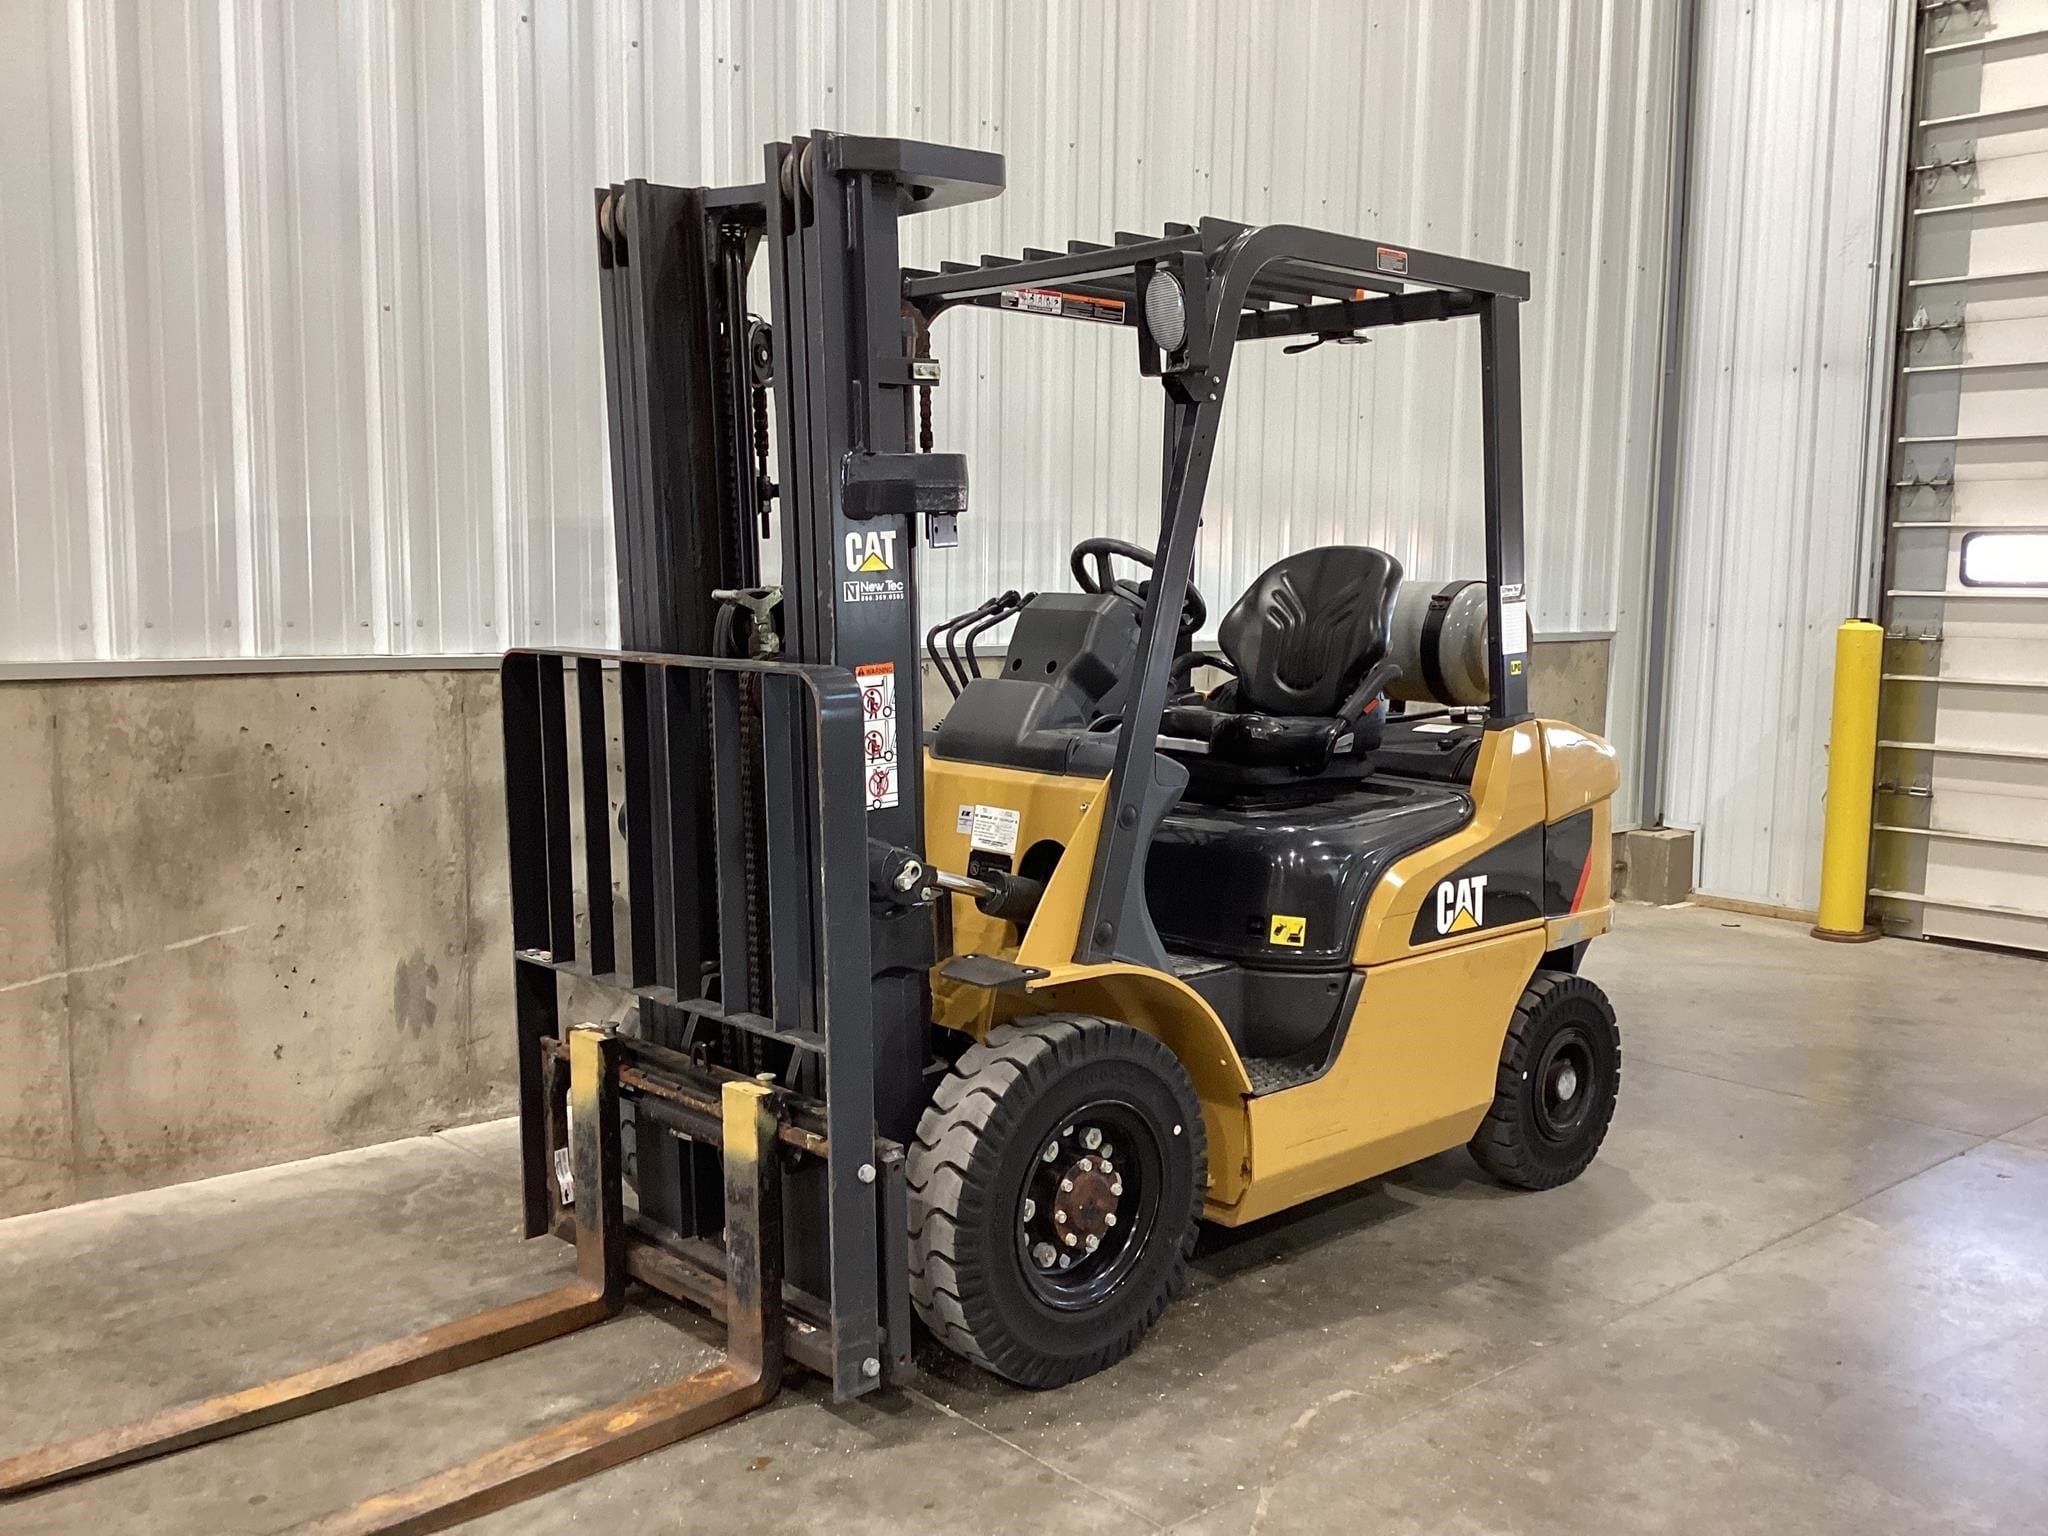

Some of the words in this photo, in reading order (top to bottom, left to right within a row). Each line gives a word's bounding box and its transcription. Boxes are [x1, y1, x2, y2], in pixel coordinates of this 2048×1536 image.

[845, 530, 897, 573] CAT
[860, 581, 885, 593] New
[885, 579, 904, 591] Tec
[866, 666, 894, 676] WARNING
[1437, 874, 1488, 935] CAT
